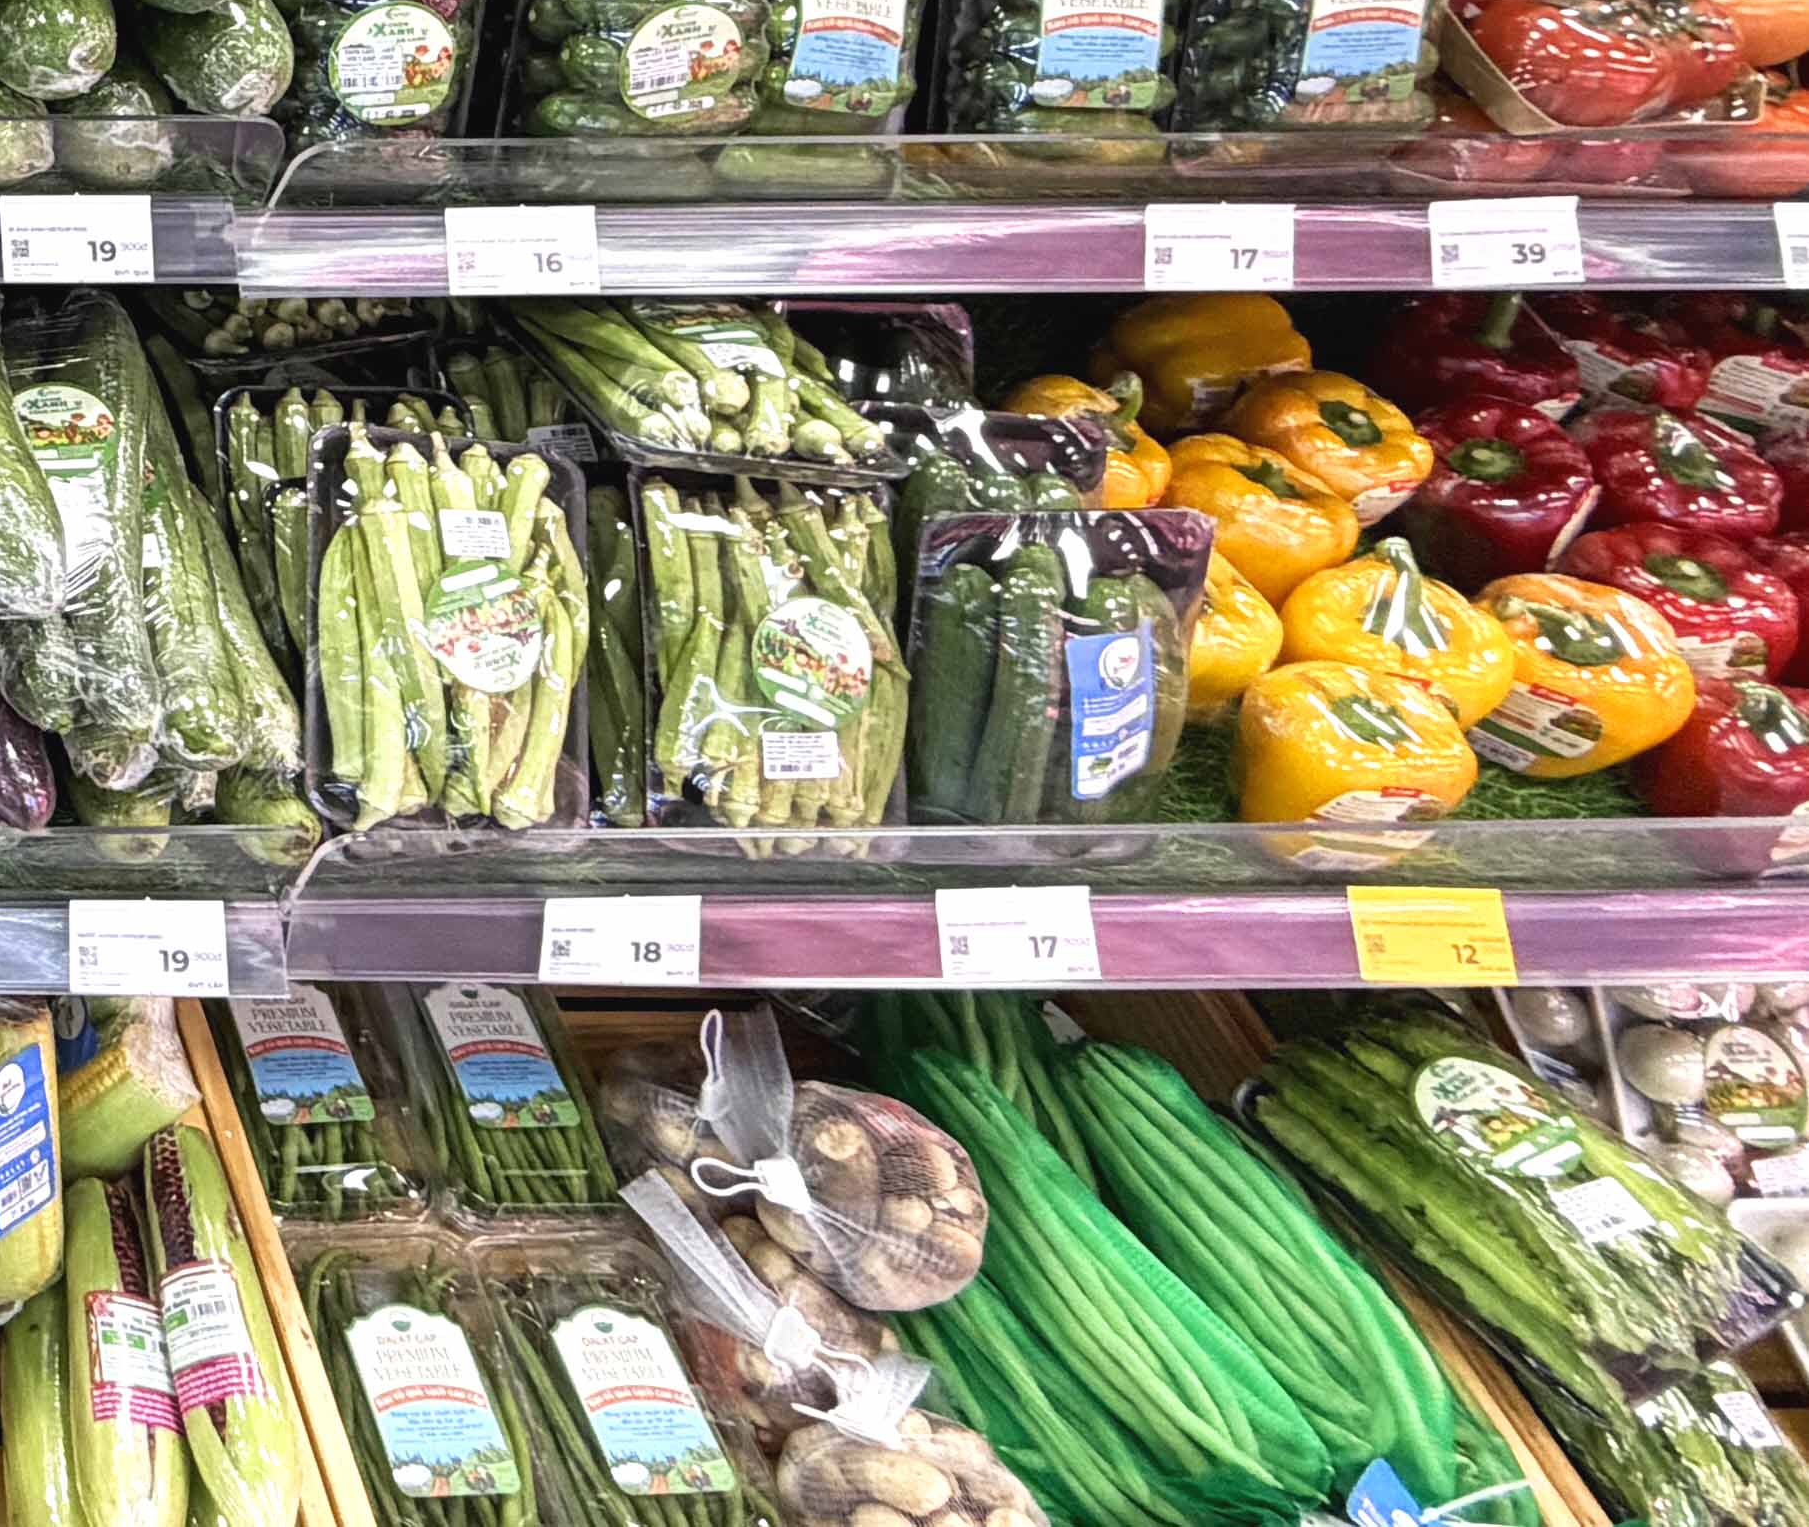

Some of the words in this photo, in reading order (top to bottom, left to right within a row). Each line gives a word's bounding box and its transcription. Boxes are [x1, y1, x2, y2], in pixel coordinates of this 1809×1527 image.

[87, 240, 117, 263] 19
[533, 252, 563, 273] 16
[1229, 248, 1259, 270] 17
[1511, 242, 1546, 265] 39
[630, 941, 662, 963] 18
[1028, 935, 1058, 959] 17
[1452, 944, 1481, 966] 12
[158, 949, 190, 973] 19
